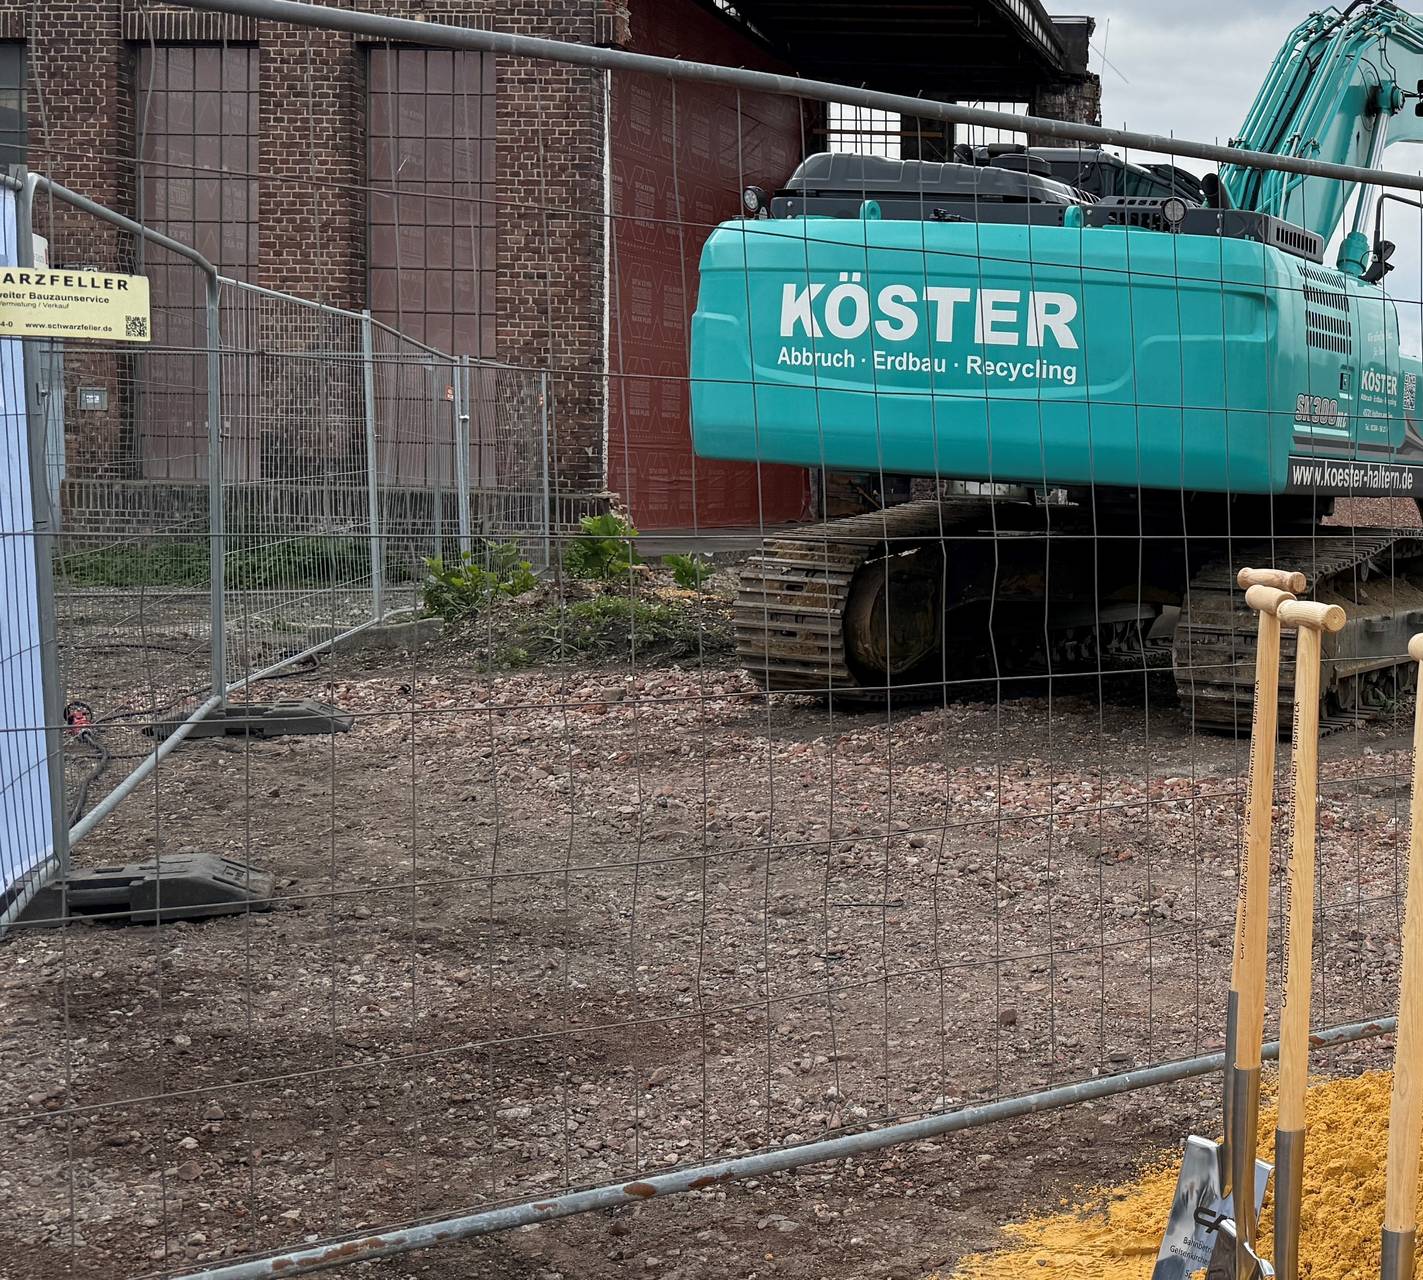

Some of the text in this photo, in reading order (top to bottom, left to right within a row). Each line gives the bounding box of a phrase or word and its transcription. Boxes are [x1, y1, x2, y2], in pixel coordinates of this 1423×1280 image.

[29, 291, 110, 304] Bauzaunservice
[779, 271, 1080, 350] KÖSTER
[777, 346, 856, 368] Abbruch
[873, 350, 946, 373] Erdbau
[966, 355, 1077, 386] Recycling
[1361, 367, 1398, 396] KÖSTER
[1292, 460, 1414, 490] www.koester-haltern.de
